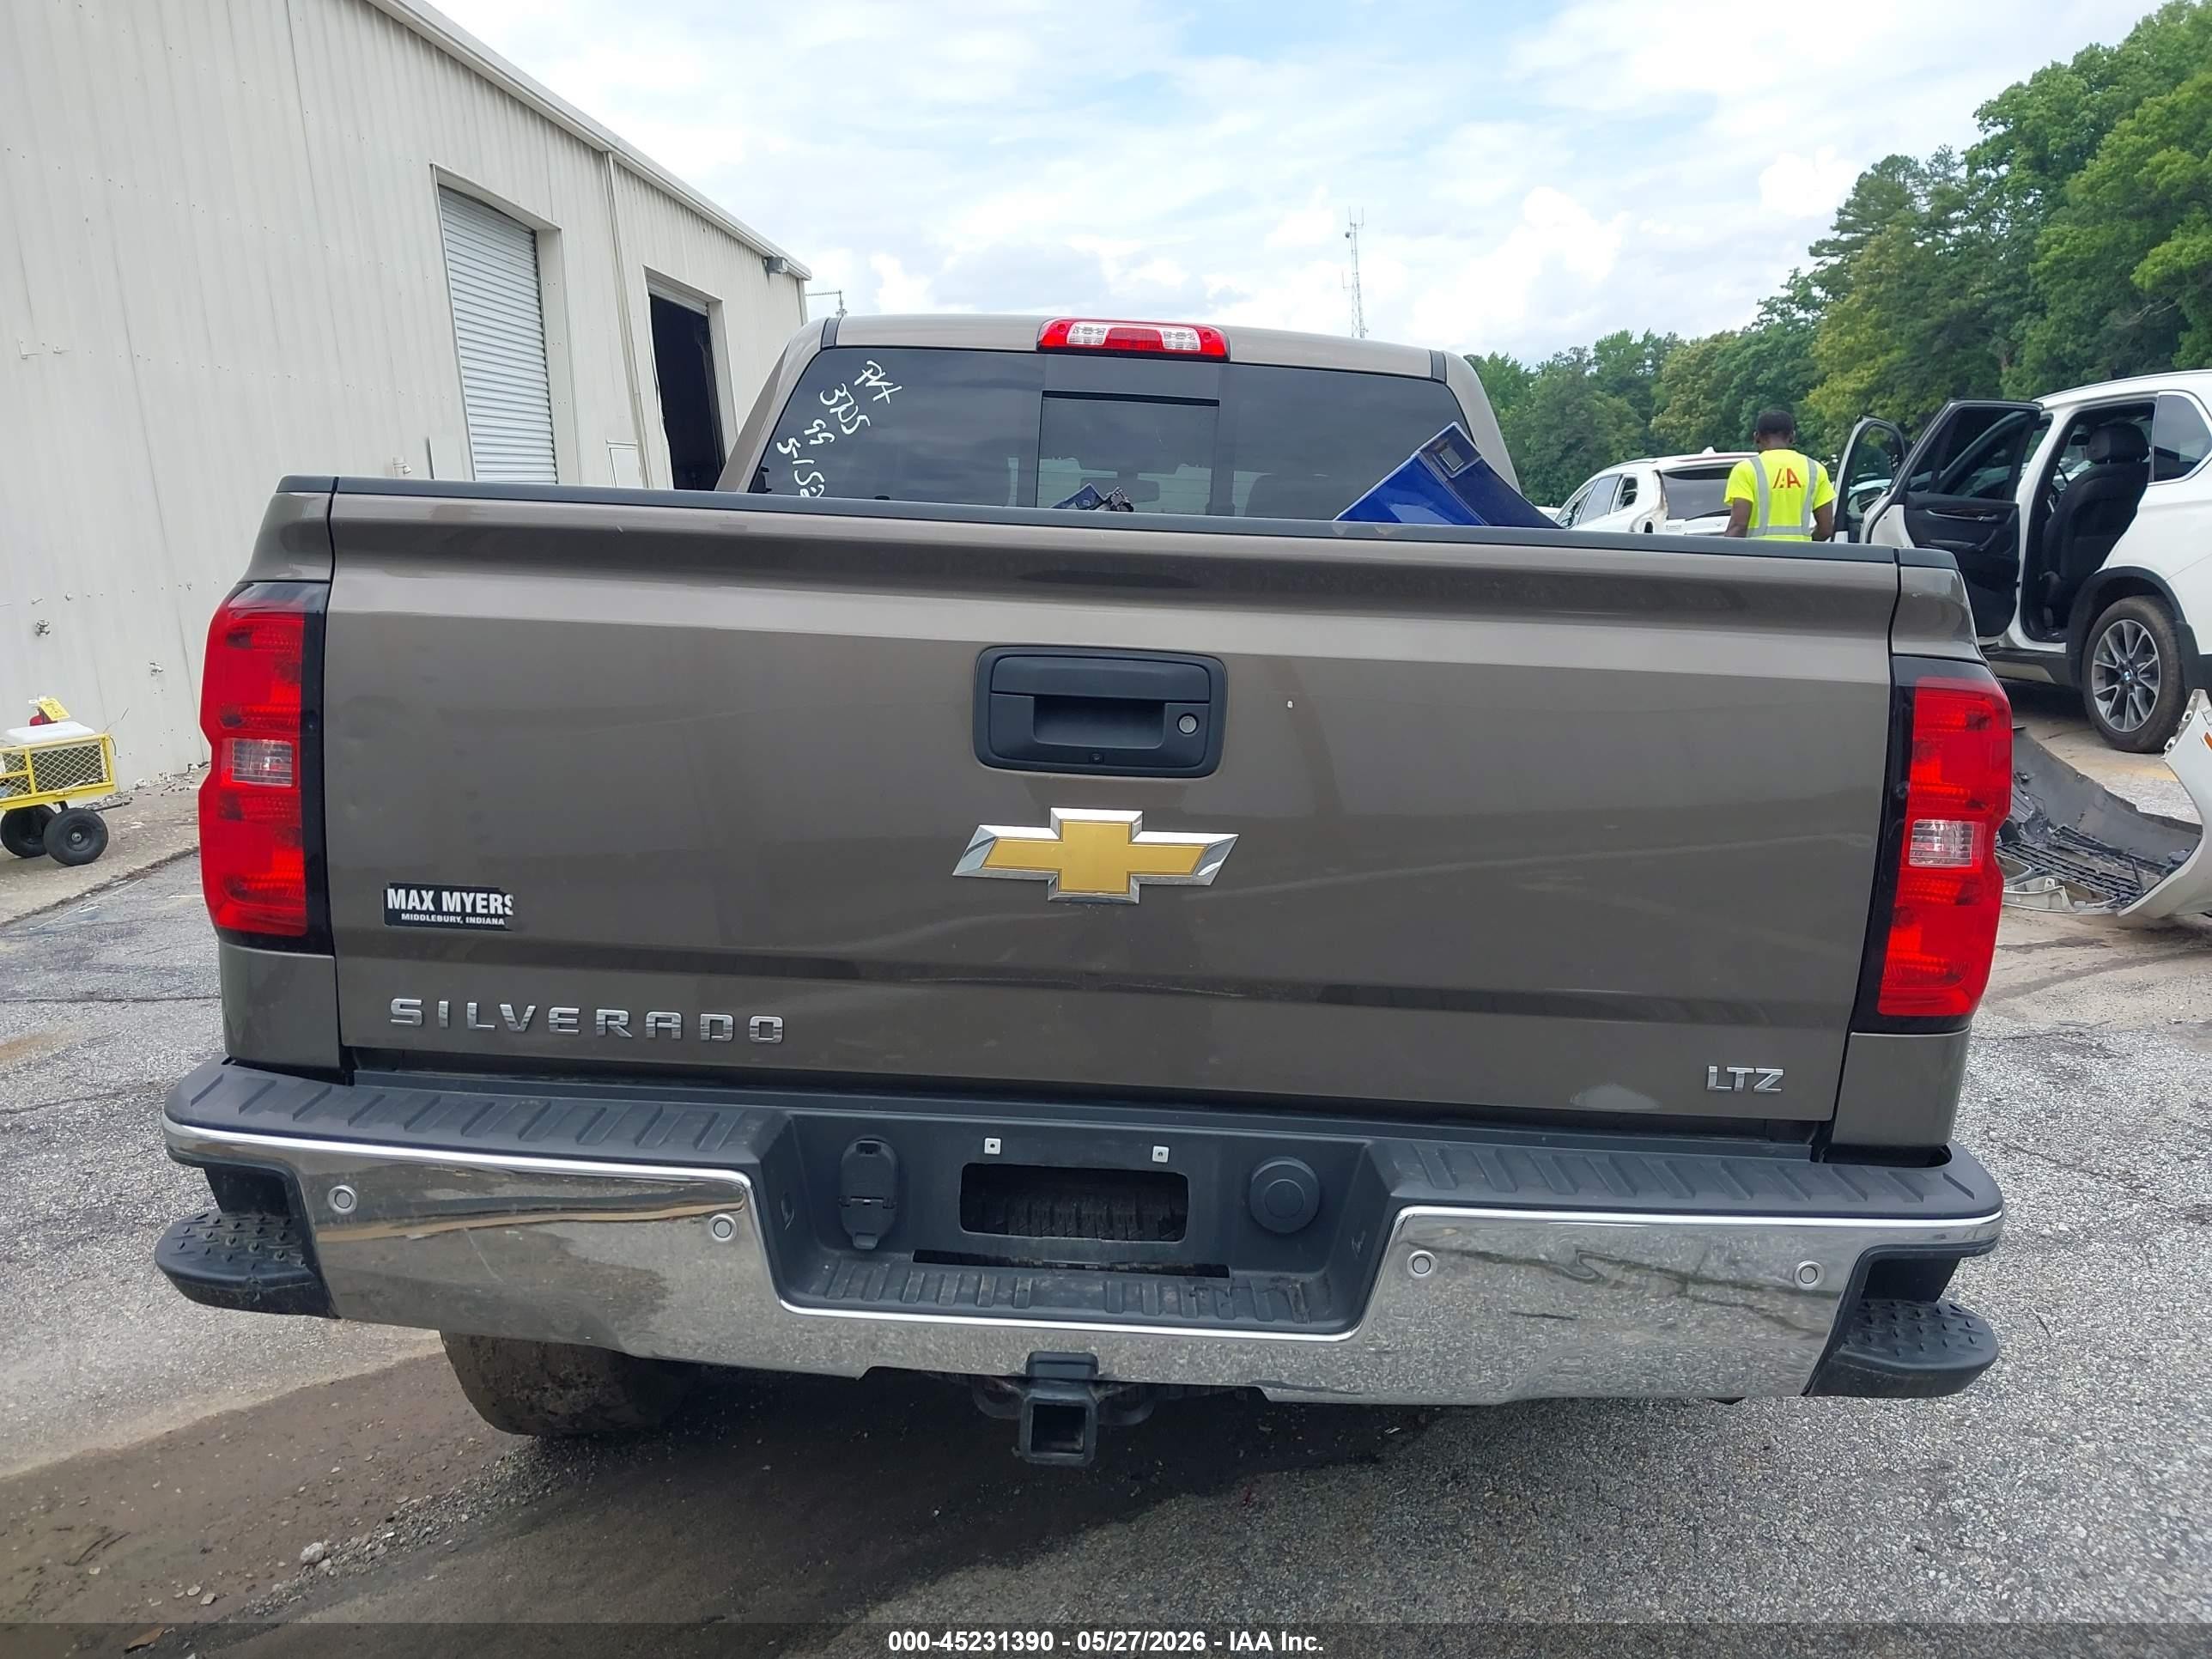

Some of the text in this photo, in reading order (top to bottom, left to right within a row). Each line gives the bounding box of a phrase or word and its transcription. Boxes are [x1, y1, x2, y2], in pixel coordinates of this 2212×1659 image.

[387, 888, 514, 915] MAX MYERS
[401, 913, 505, 926] MIDDLEBURY, INDIANA
[390, 998, 784, 1044] SILVERADO
[1706, 1066, 1784, 1092] LTZ
